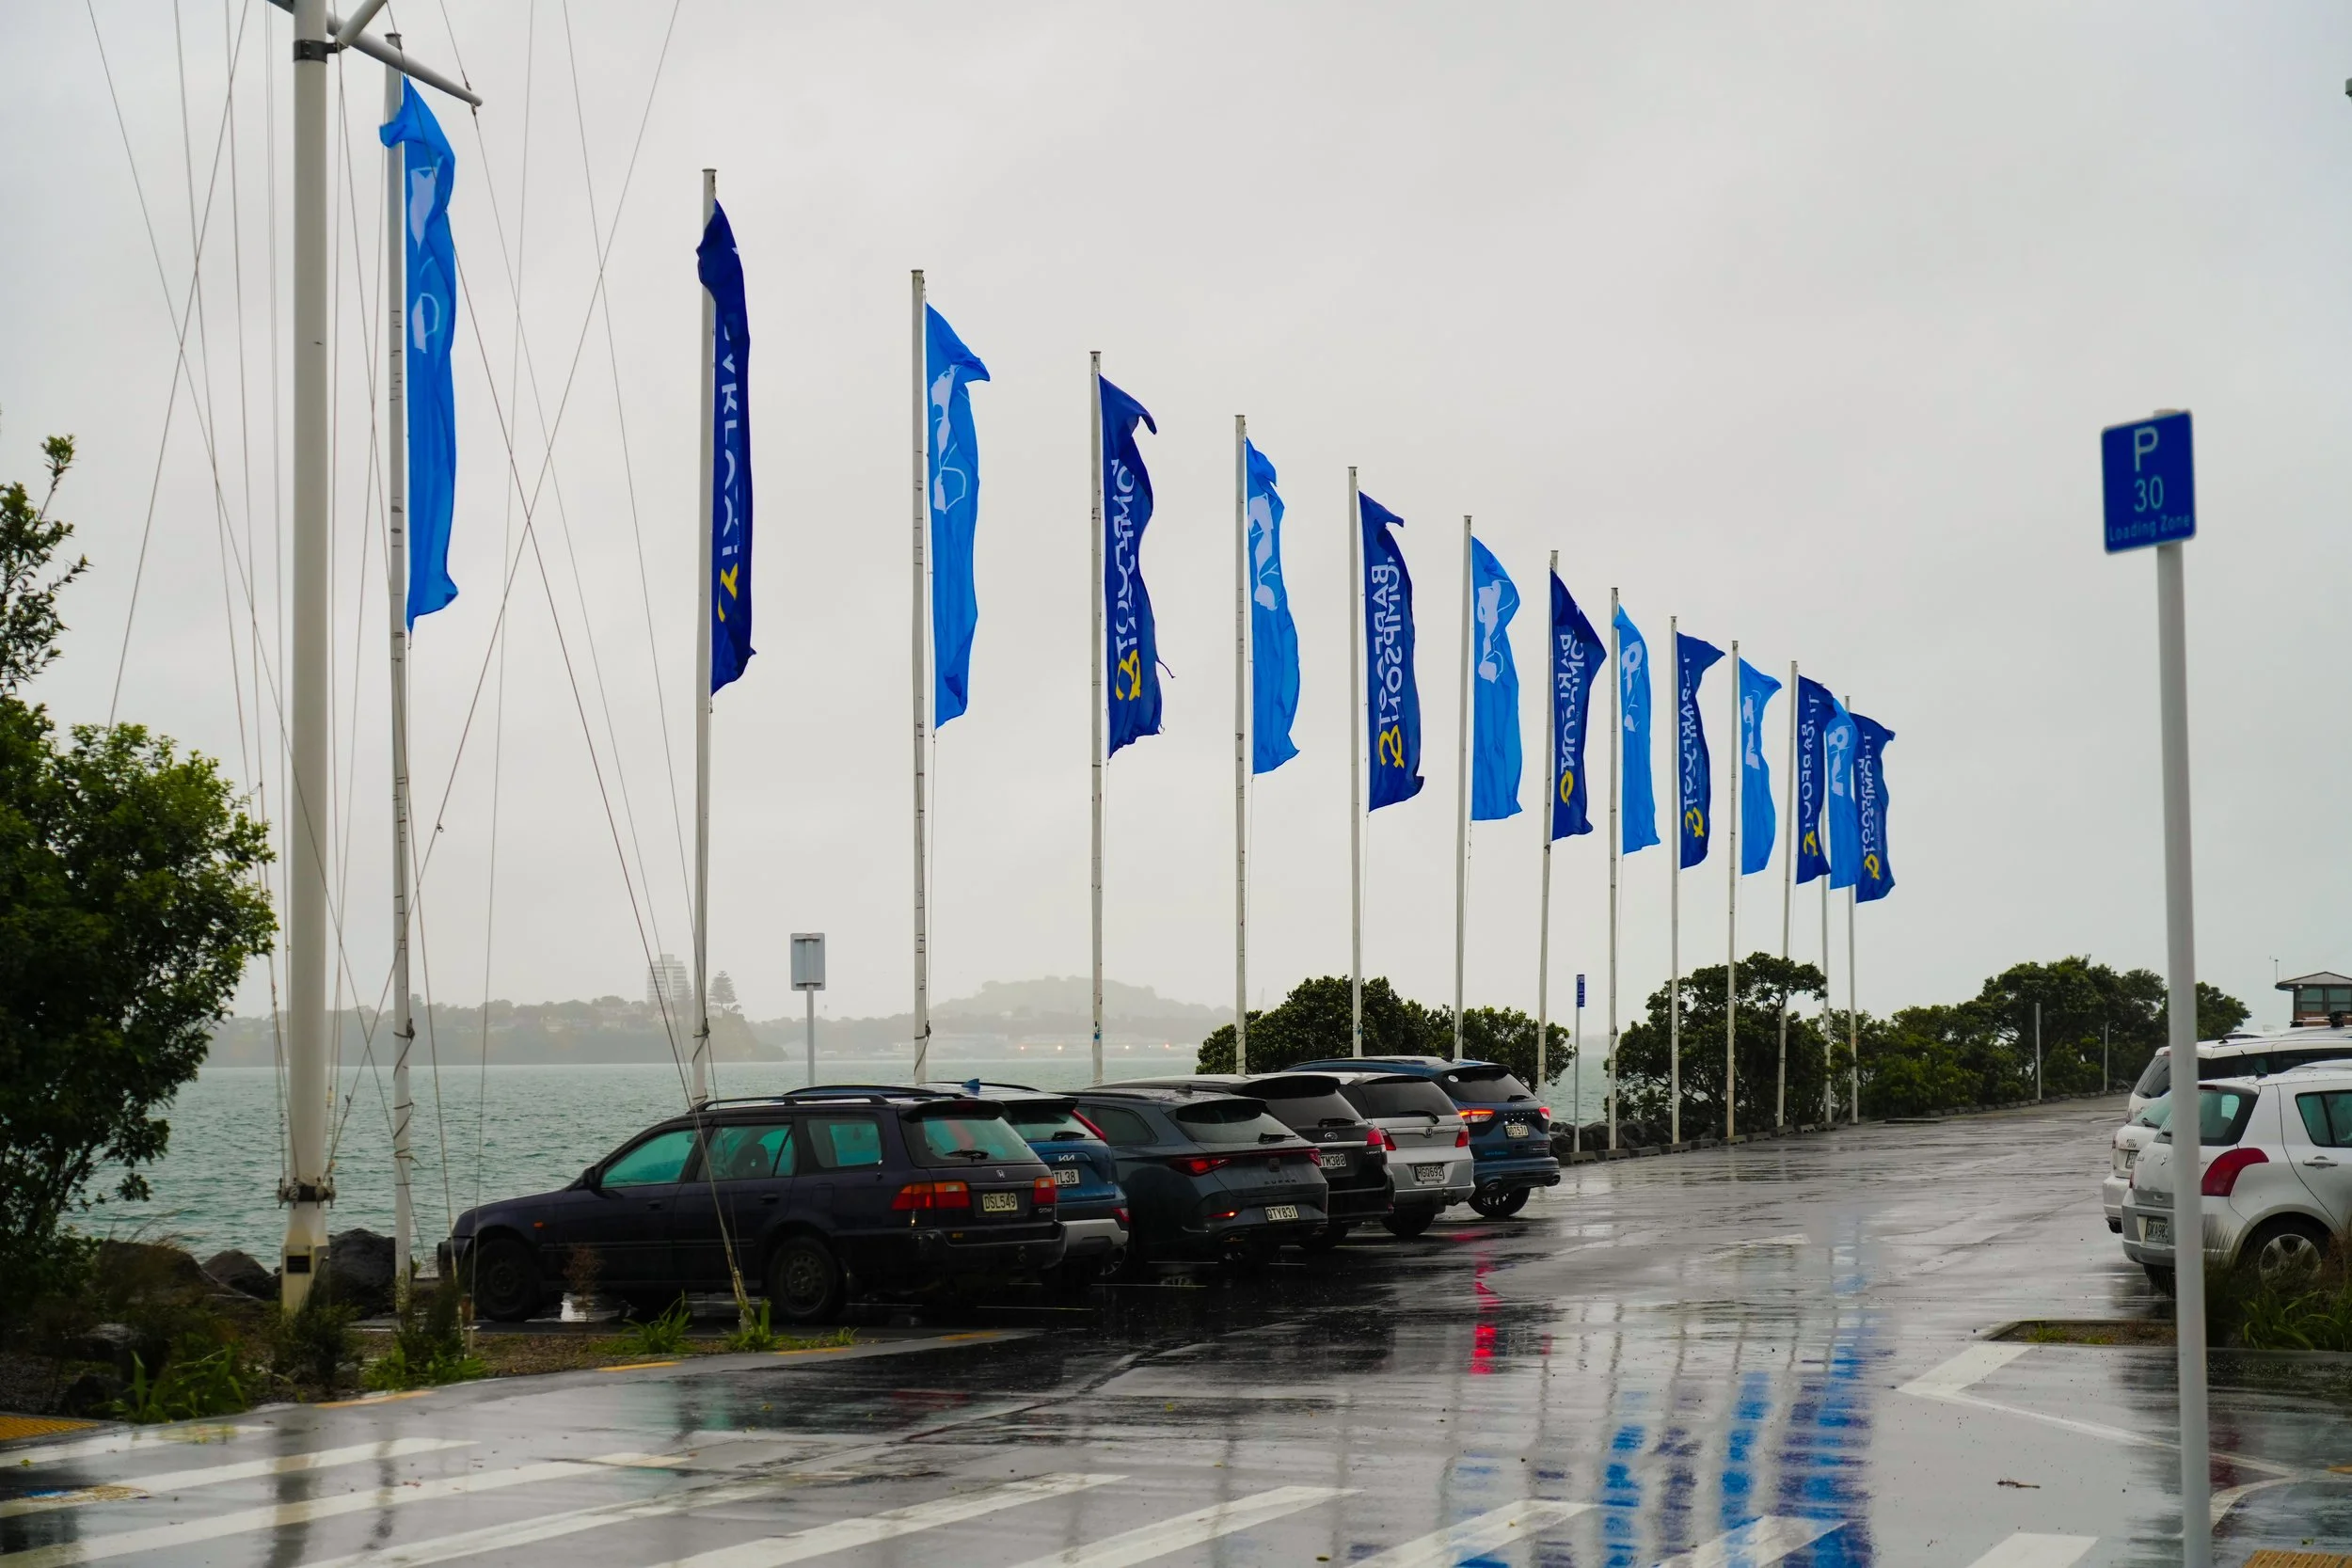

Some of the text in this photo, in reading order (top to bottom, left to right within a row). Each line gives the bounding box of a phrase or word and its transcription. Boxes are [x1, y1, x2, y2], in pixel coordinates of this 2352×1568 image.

[2134, 426, 2159, 472] P
[2134, 475, 2163, 513] 30
[2108, 515, 2191, 543] Loading Zone
[1319, 1155, 1345, 1166] TM300
[1053, 1170, 1076, 1184] TL38
[984, 1195, 1017, 1211] DSL549
[1265, 1207, 1297, 1220] QTY831
